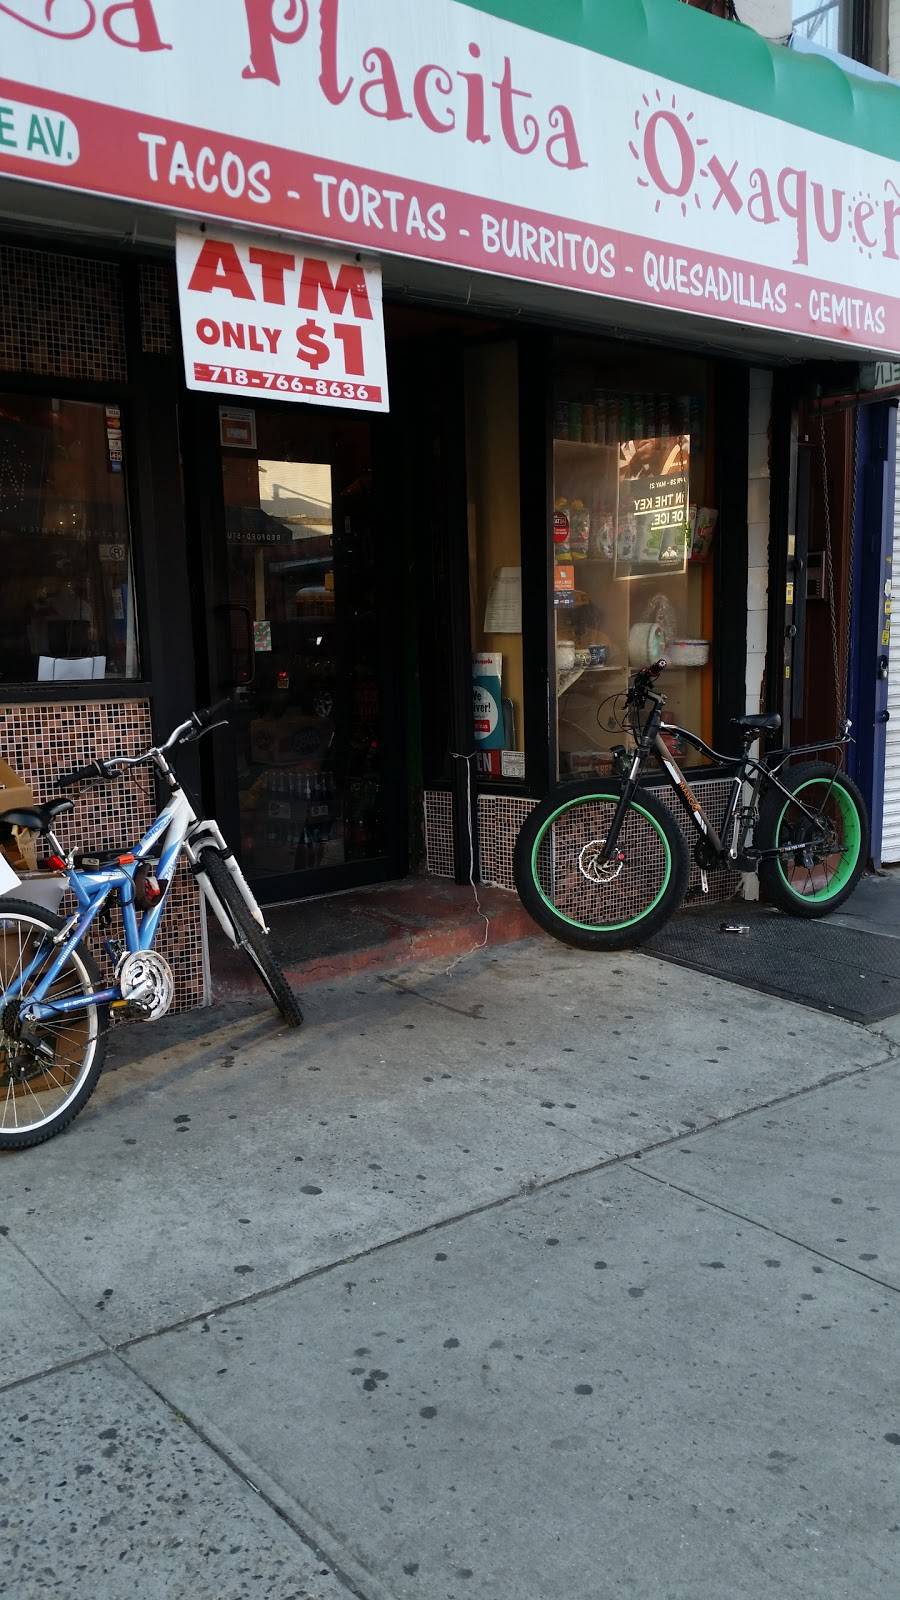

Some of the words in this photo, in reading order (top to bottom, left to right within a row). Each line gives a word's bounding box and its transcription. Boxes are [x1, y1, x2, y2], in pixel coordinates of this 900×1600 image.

[27, 113, 73, 160] AV.
[138, 131, 272, 204] TACOS
[313, 172, 447, 243] TORTAS
[481, 213, 616, 280] BURRITOS
[643, 250, 787, 315] QUESADILLAS
[808, 290, 886, 335] CEMITAS
[187, 239, 374, 321] ATM
[196, 318, 283, 355] ONLY
[296, 318, 366, 377] $1
[208, 364, 370, 401] 718-766-8636
